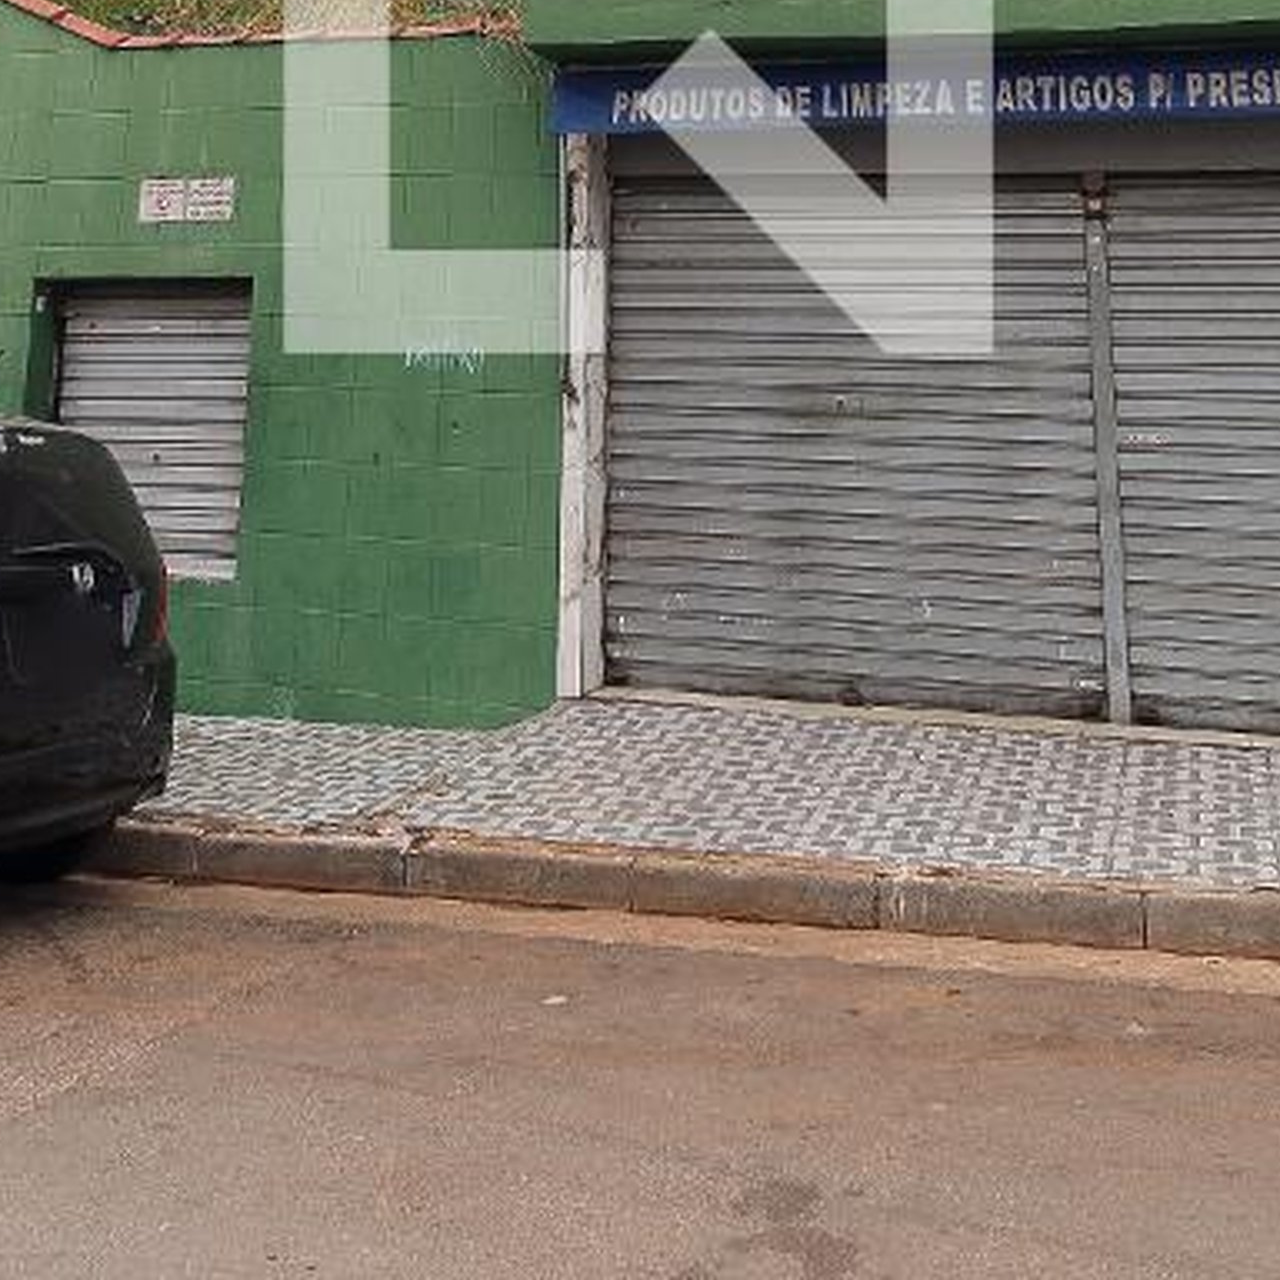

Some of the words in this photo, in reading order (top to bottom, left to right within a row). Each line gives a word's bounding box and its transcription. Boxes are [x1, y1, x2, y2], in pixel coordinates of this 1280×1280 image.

[612, 86, 763, 124] PRODUTOS
[775, 85, 811, 118] DE
[822, 80, 955, 118] LIMPEZA
[965, 79, 985, 114] E
[996, 75, 1135, 112] ARTIGOS
